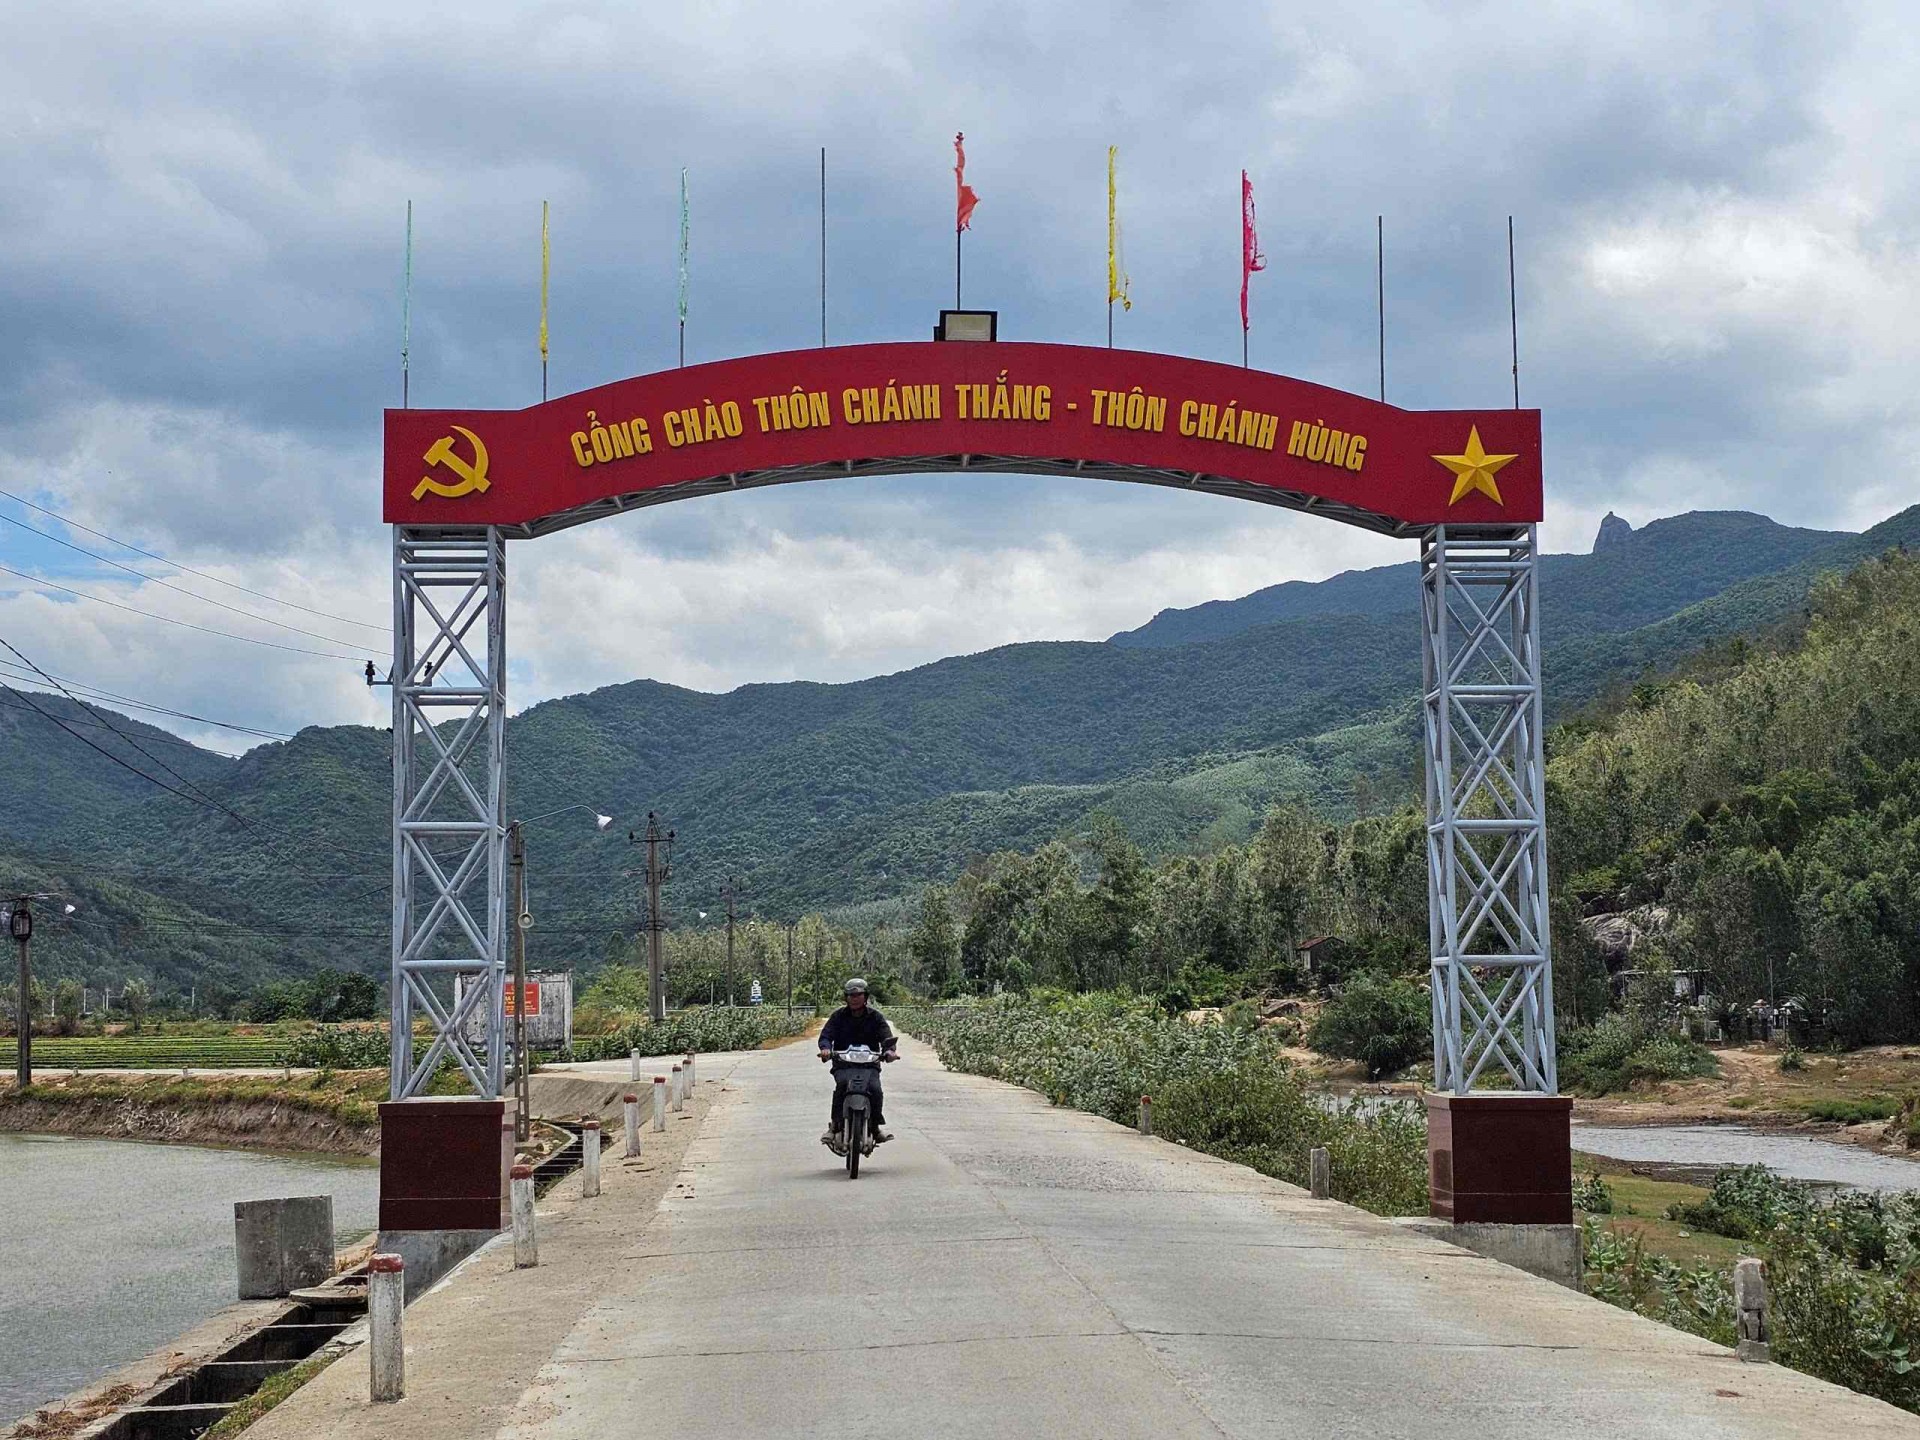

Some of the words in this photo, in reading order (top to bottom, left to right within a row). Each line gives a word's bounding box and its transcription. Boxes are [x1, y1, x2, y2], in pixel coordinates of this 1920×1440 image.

[571, 410, 653, 467] CỔNG
[663, 399, 743, 447] CHÀO
[753, 385, 830, 432] THÔN
[843, 379, 941, 424] CHÁNH
[955, 369, 1051, 421] THẮNG
[1067, 402, 1077, 410] -
[1091, 386, 1167, 432] THÔN
[1180, 400, 1279, 450] CHÁNH
[1287, 419, 1367, 471] HÙNG
